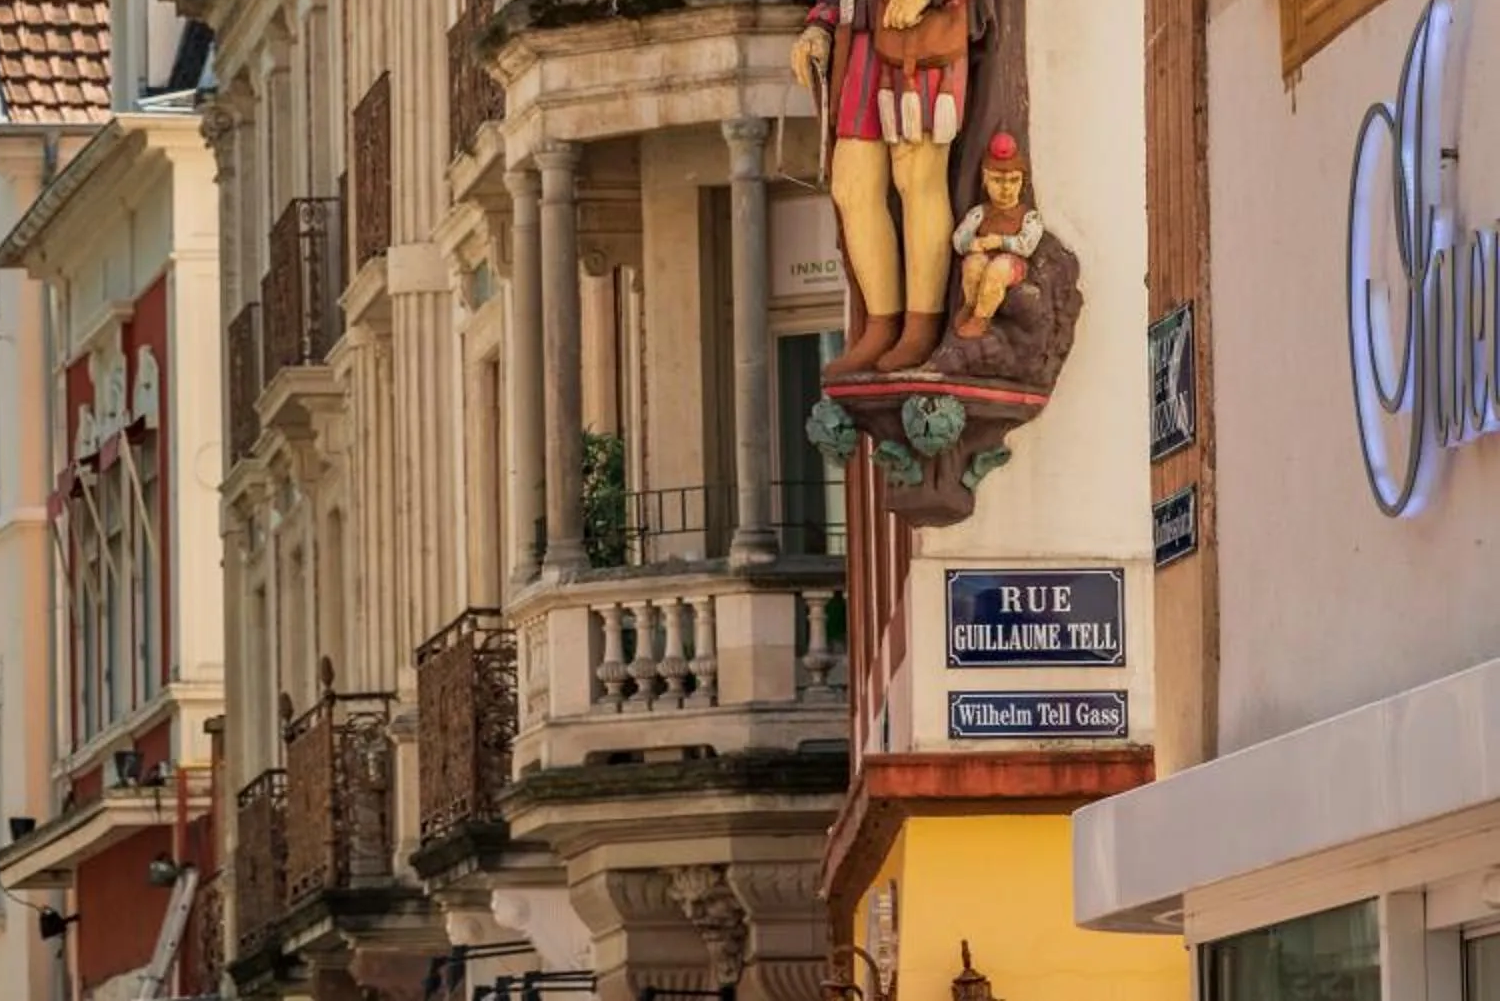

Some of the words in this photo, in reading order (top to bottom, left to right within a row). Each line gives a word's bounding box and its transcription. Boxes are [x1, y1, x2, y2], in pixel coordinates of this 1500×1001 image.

[790, 260, 841, 276] INNO
[1000, 586, 1071, 612] RUE
[955, 624, 1061, 650] GUILLAUME
[1068, 623, 1117, 650] TELL
[958, 703, 1033, 727] Wilhelm
[1037, 703, 1071, 726] Tell
[1076, 703, 1120, 726] Gass
